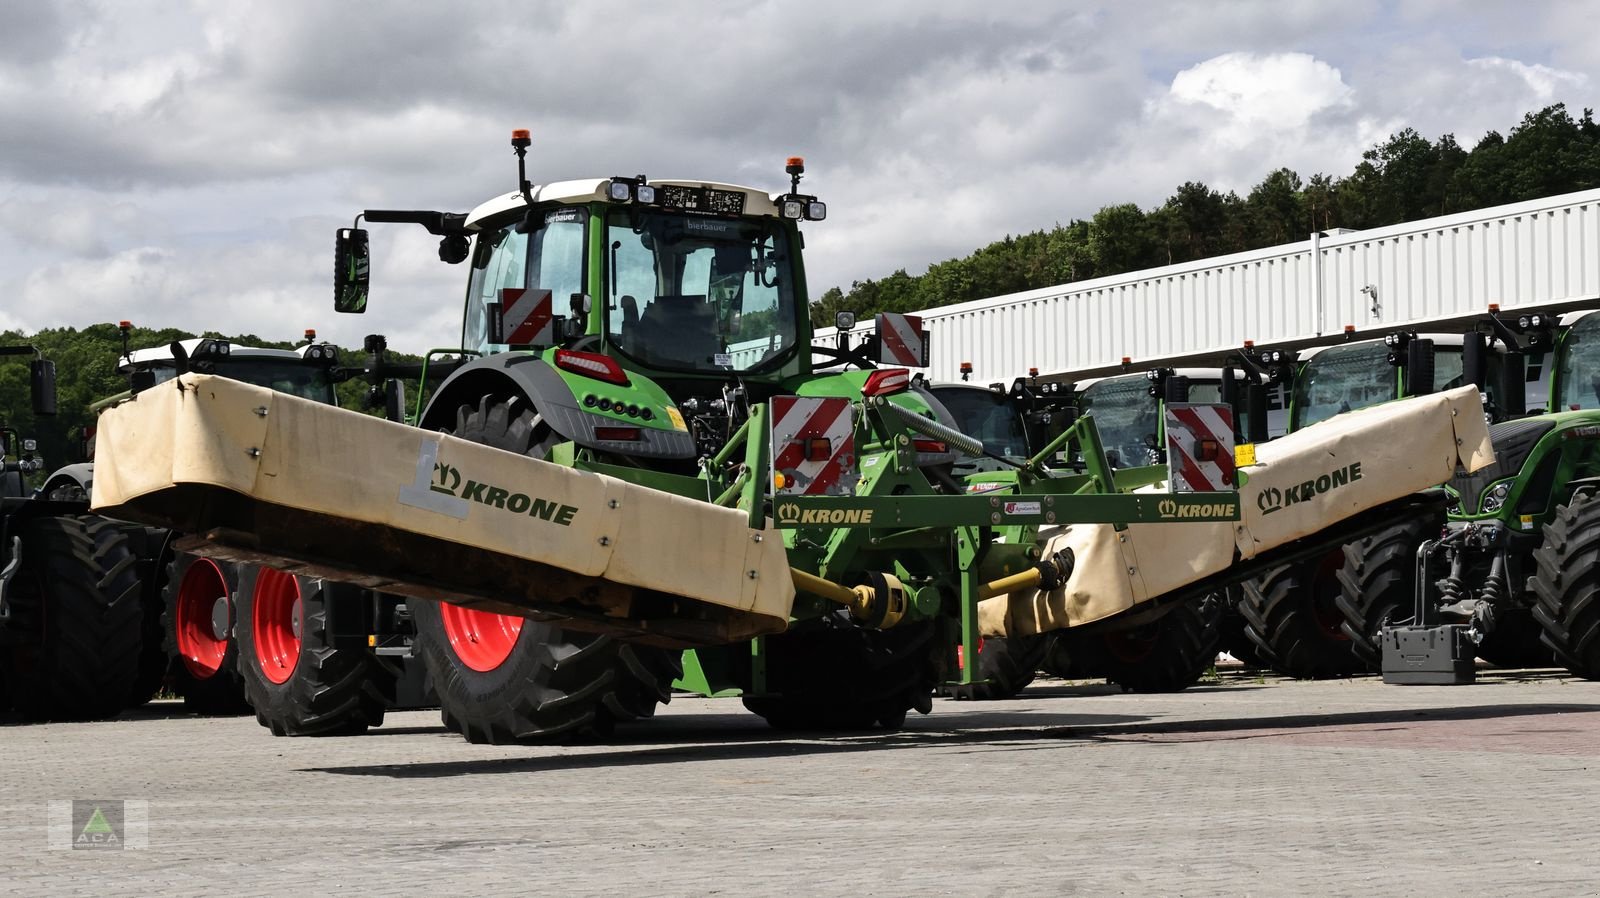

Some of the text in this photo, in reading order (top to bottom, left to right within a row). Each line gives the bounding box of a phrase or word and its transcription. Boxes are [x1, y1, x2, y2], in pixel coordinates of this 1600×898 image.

[544, 211, 575, 223] bierbauer
[687, 219, 727, 232] bierbauer
[1284, 462, 1362, 507] KRONE
[461, 480, 579, 526] KRONE
[801, 509, 874, 523] KRONE
[1177, 504, 1235, 518] KRONE
